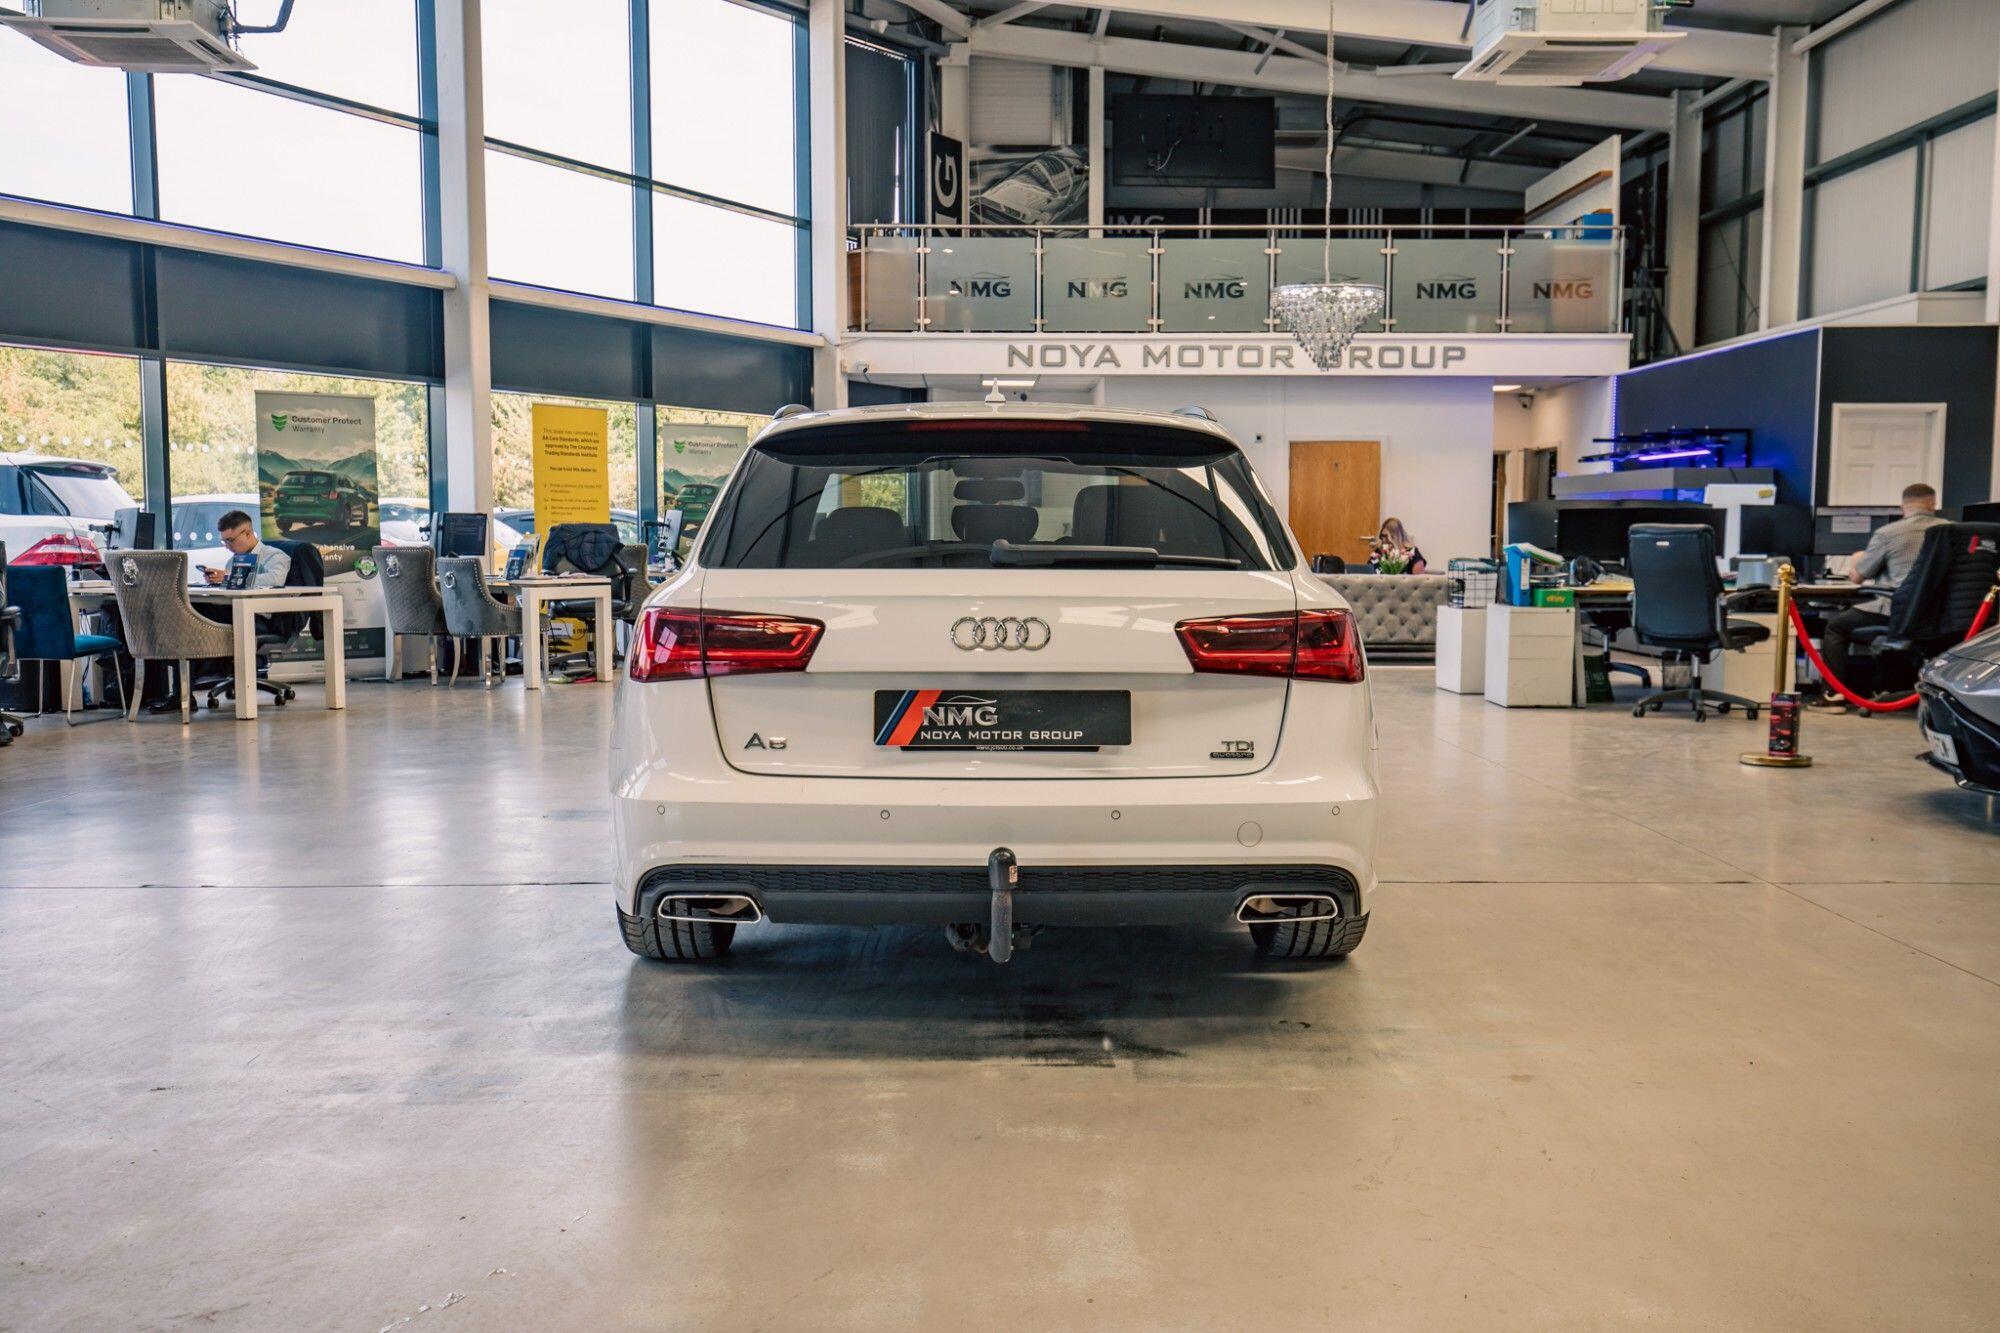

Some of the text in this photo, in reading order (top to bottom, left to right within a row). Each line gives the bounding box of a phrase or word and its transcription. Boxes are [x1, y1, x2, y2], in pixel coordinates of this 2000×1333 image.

[950, 280, 1011, 298] NMG
[1068, 281, 1128, 298] NMG
[1184, 282, 1244, 299] NMG
[1416, 283, 1477, 299] NMG
[1533, 283, 1594, 299] NMG
[1008, 344, 1121, 368] NOYA
[1143, 345, 1294, 368] MOTOR
[291, 415, 361, 425] Customer Protect
[292, 425, 325, 434] Warranty
[321, 553, 343, 562] ranty
[922, 706, 999, 727] NMG
[744, 732, 787, 750] A6
[921, 730, 1083, 740] NOYA MOTOR GROUP
[1221, 740, 1255, 751] TDI
